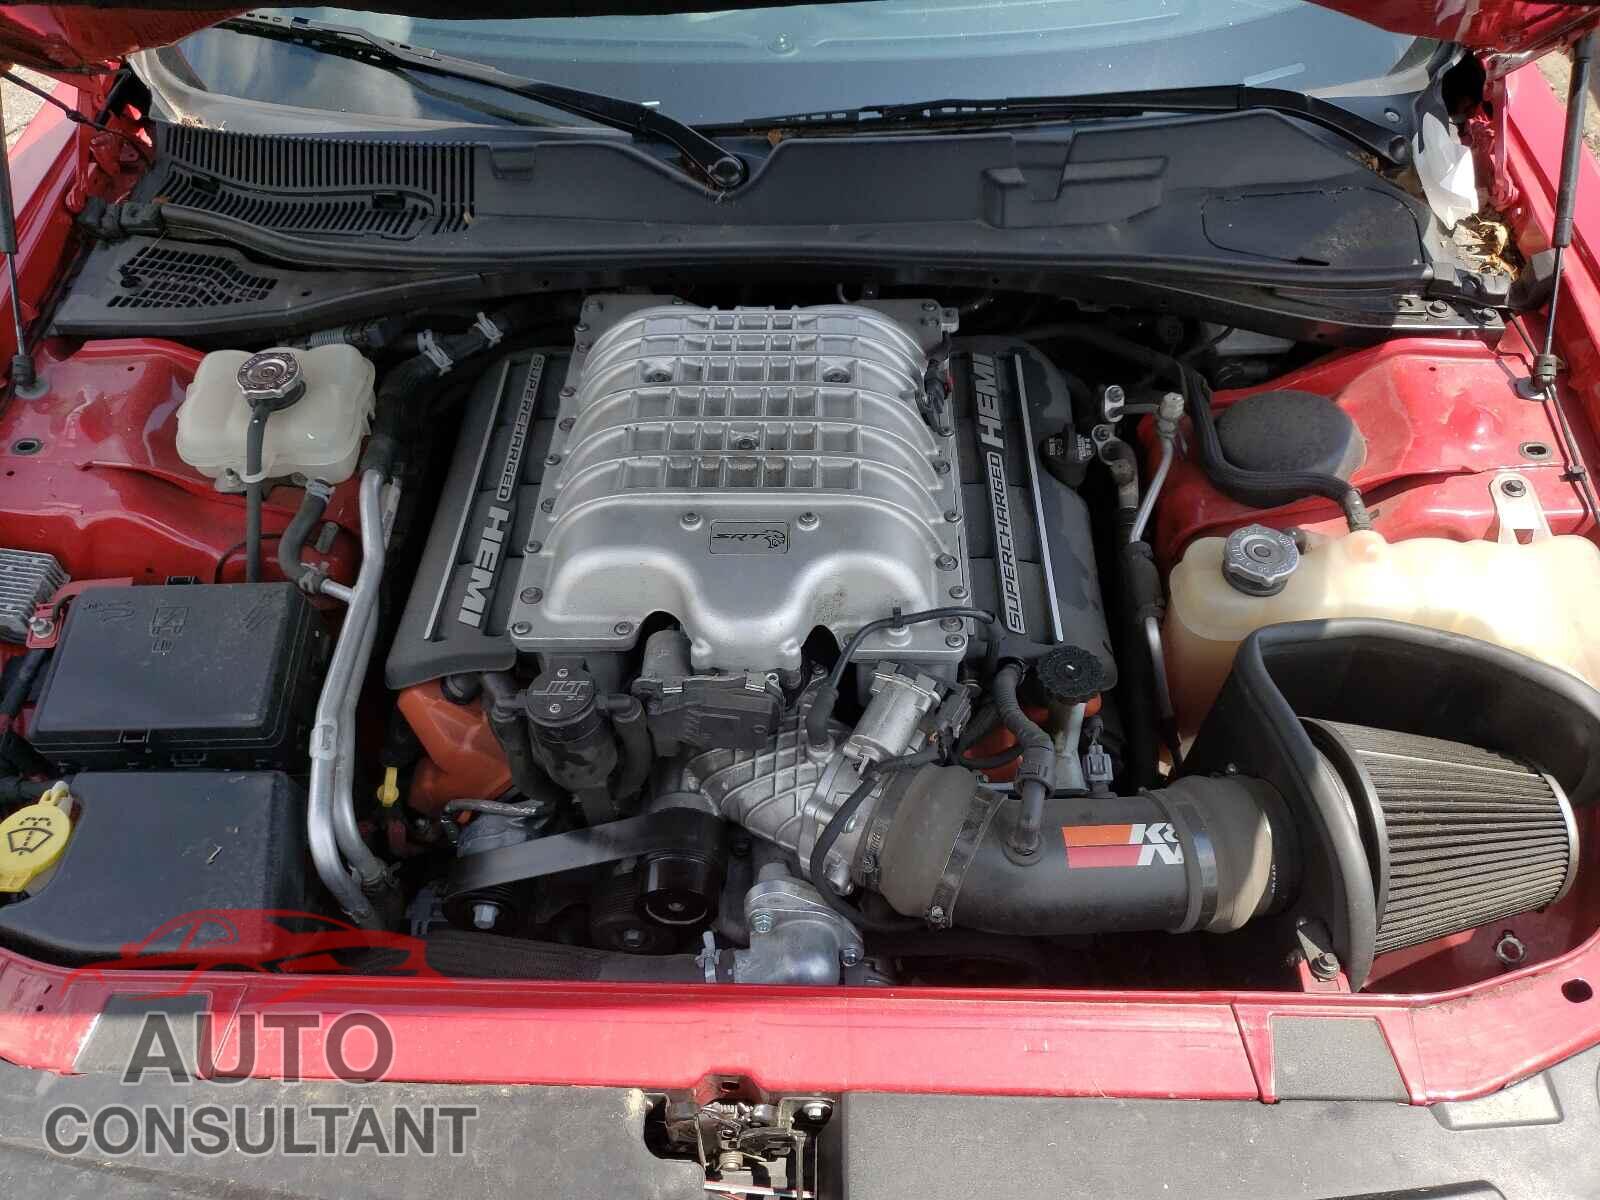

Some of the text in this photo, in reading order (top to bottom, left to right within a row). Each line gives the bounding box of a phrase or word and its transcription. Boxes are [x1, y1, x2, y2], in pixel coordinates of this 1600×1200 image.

[458, 354, 545, 627] SUPERCHARGED HEMI
[972, 352, 1026, 634] SUPERCHARGED HEMI
